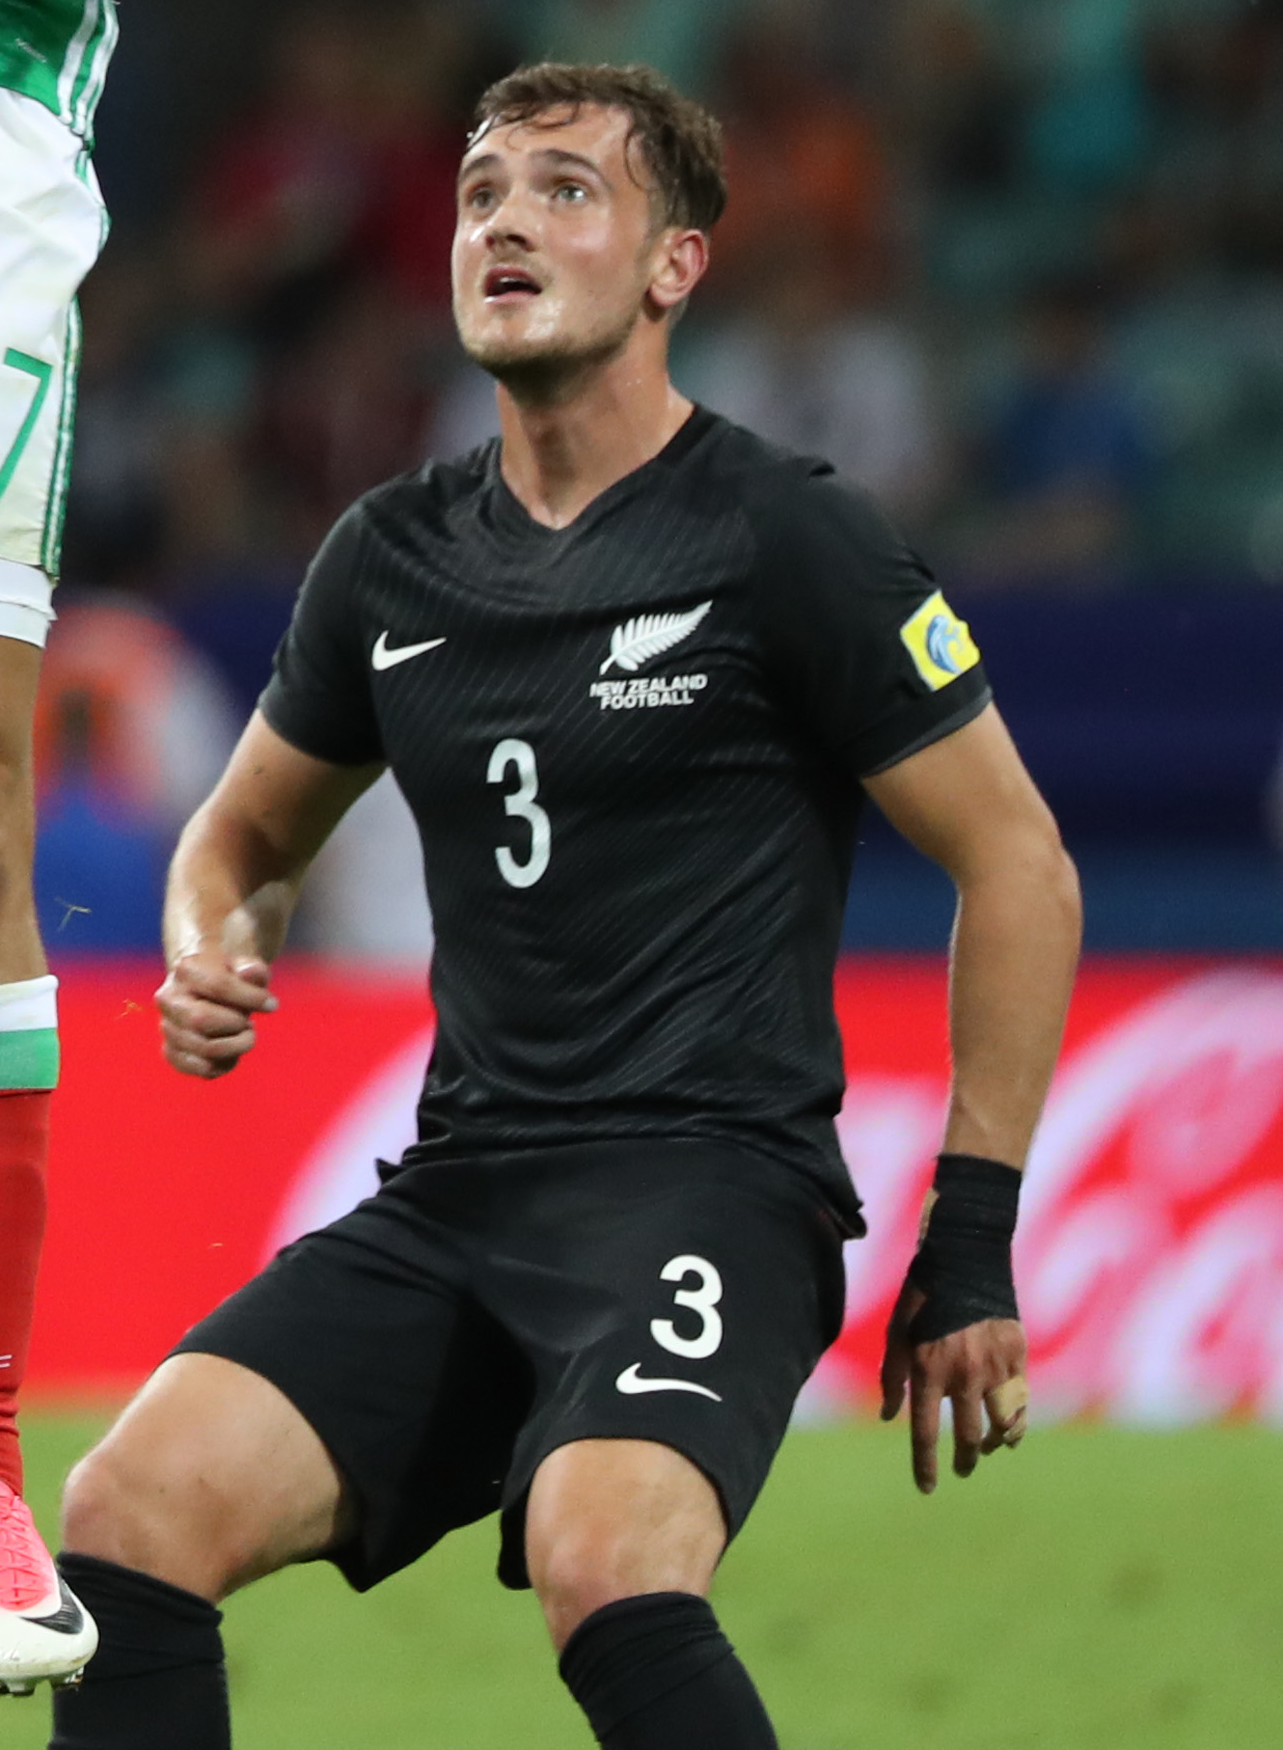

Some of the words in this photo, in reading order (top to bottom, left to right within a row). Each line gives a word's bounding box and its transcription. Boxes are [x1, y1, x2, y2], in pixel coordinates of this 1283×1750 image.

[589, 679, 627, 698] NEW
[627, 673, 708, 695] ZEALAND
[600, 690, 695, 710] FOOTBALL
[486, 738, 551, 888] 3
[650, 1254, 723, 1361] 3
